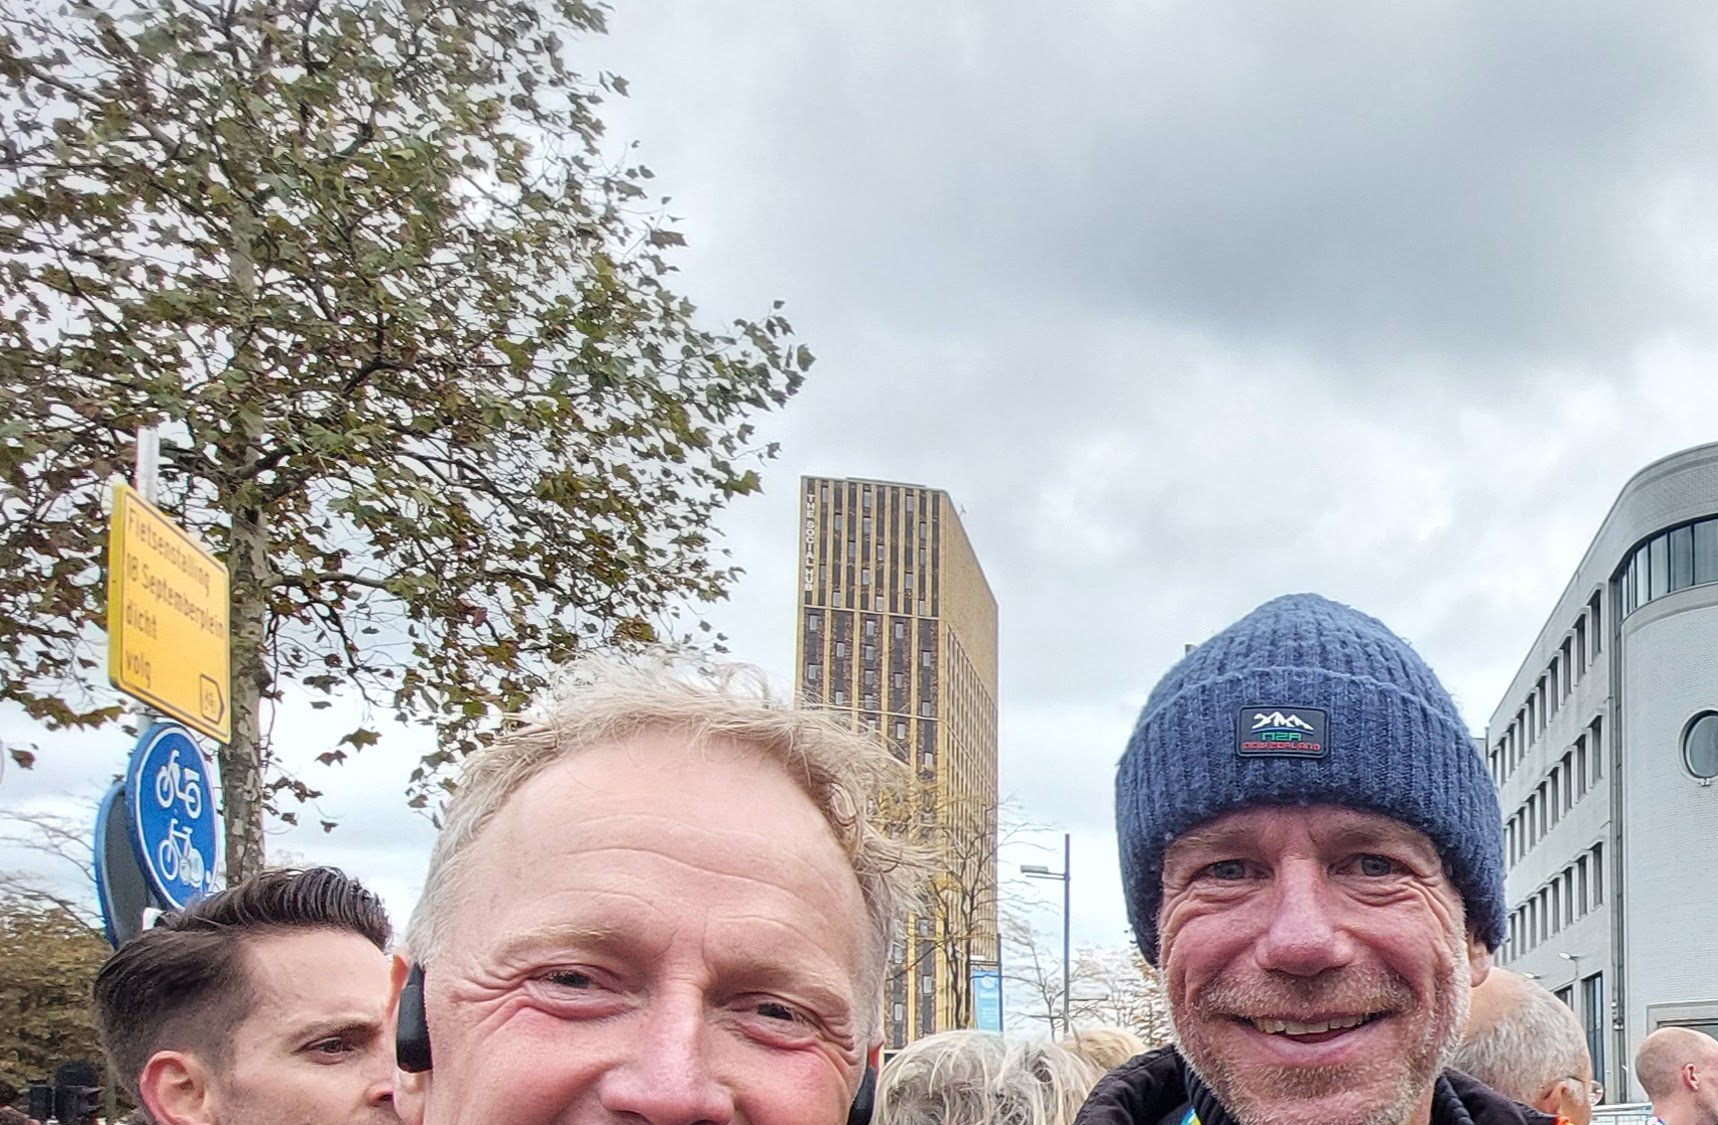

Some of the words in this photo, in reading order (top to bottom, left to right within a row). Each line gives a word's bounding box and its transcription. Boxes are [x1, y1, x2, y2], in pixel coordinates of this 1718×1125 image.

[806, 494, 816, 518] THE
[128, 506, 211, 597] Fietsenstalling
[805, 520, 816, 567] SOCIAL
[126, 552, 138, 582] 18
[142, 563, 225, 641] Septemberplein
[804, 568, 814, 591] HUB
[126, 599, 158, 640] dicht
[125, 649, 151, 689] volg
